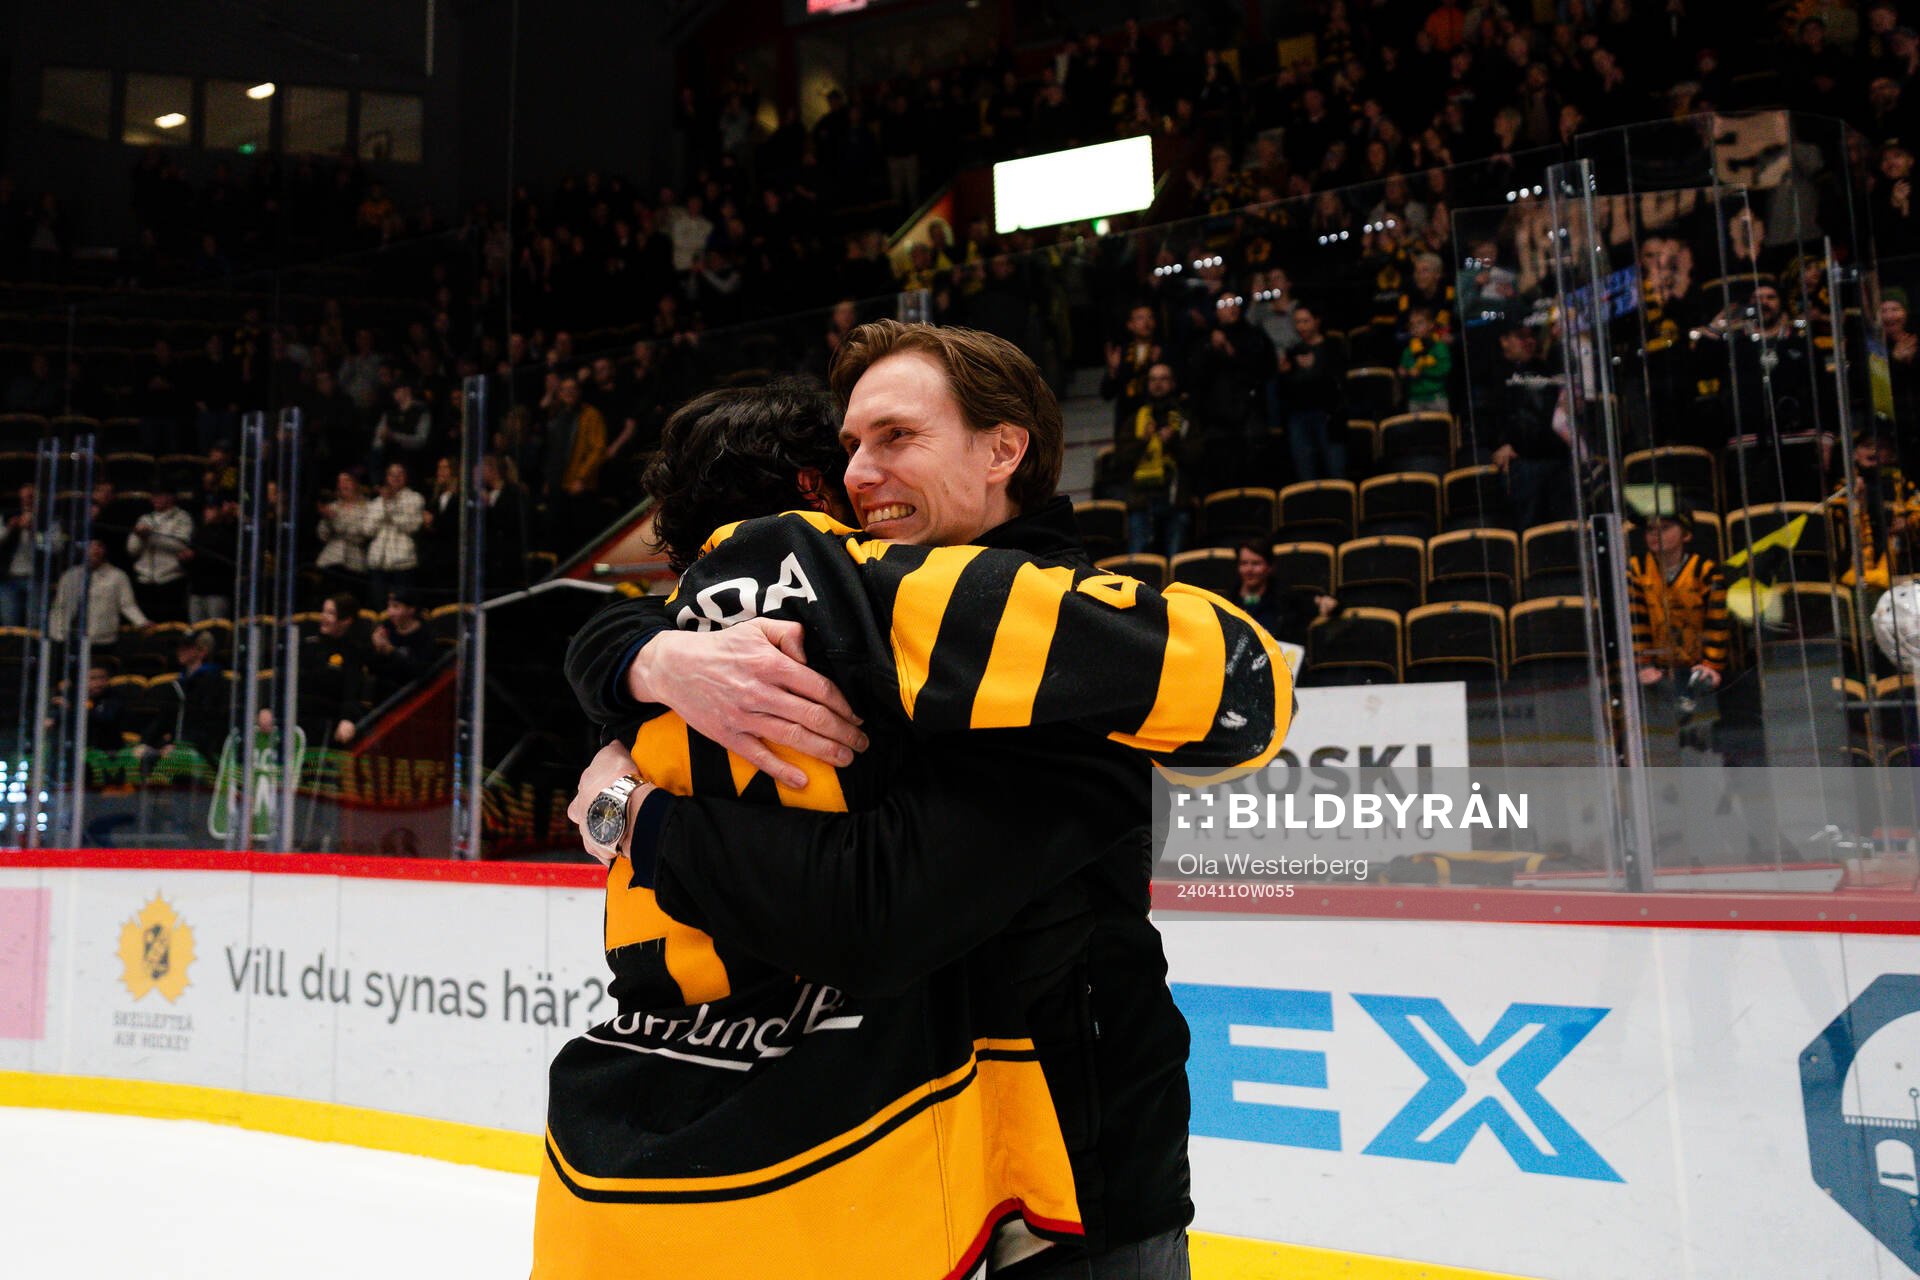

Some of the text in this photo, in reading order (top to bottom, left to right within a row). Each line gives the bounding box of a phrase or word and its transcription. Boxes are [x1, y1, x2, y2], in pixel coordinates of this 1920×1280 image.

[224, 945, 604, 1029] Vill du synas här?
